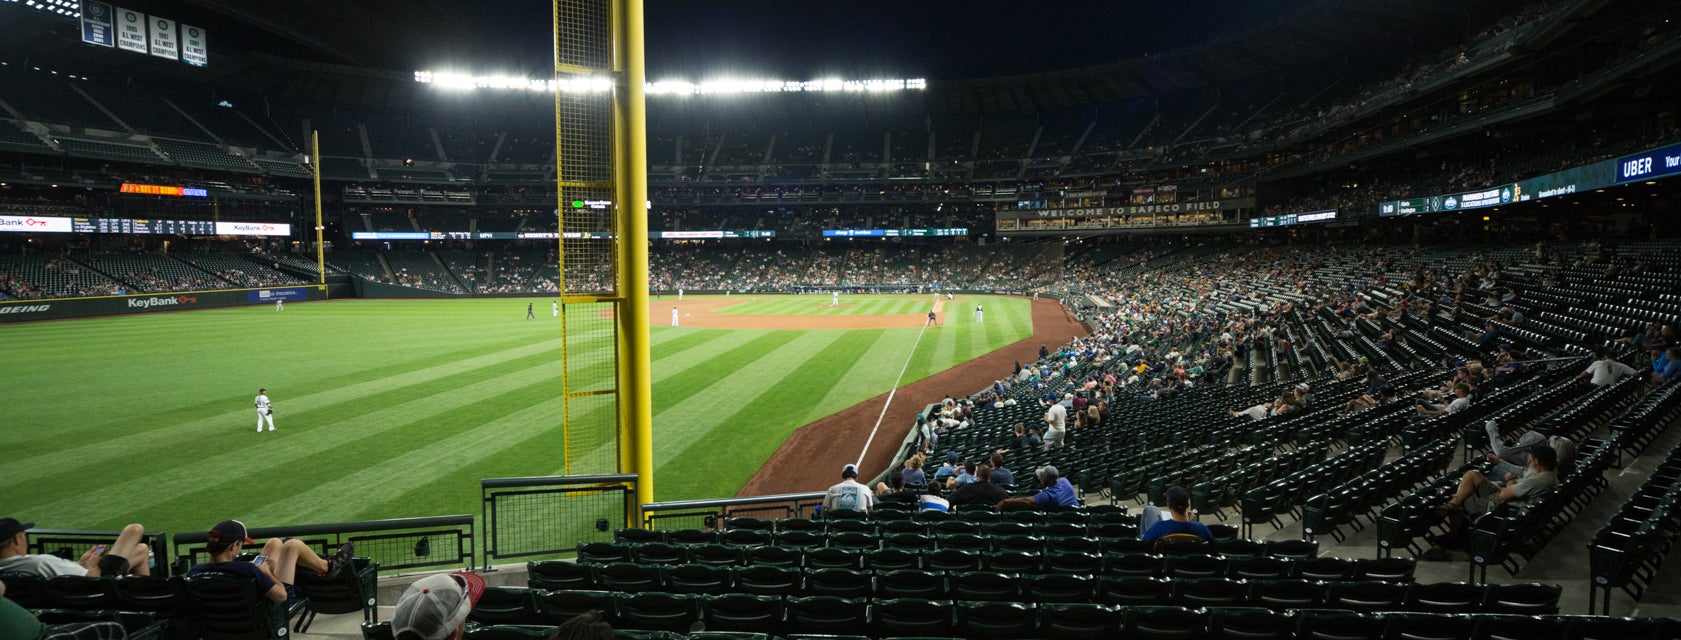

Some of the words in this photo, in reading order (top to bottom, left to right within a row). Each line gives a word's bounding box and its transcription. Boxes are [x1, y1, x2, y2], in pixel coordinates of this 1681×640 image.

[120, 40, 145, 51] CHAMPIONS
[153, 47, 176, 57] CHAMPIONS
[184, 53, 206, 62] CHAMPIONS
[1624, 157, 1652, 177] UBER
[1666, 156, 1680, 167] Your
[1038, 208, 1103, 217] WELCOME
[1131, 204, 1180, 214] SAFECO
[1186, 201, 1220, 210] FIELD
[128, 296, 178, 309] KeyBank
[0, 304, 51, 314] OEING
